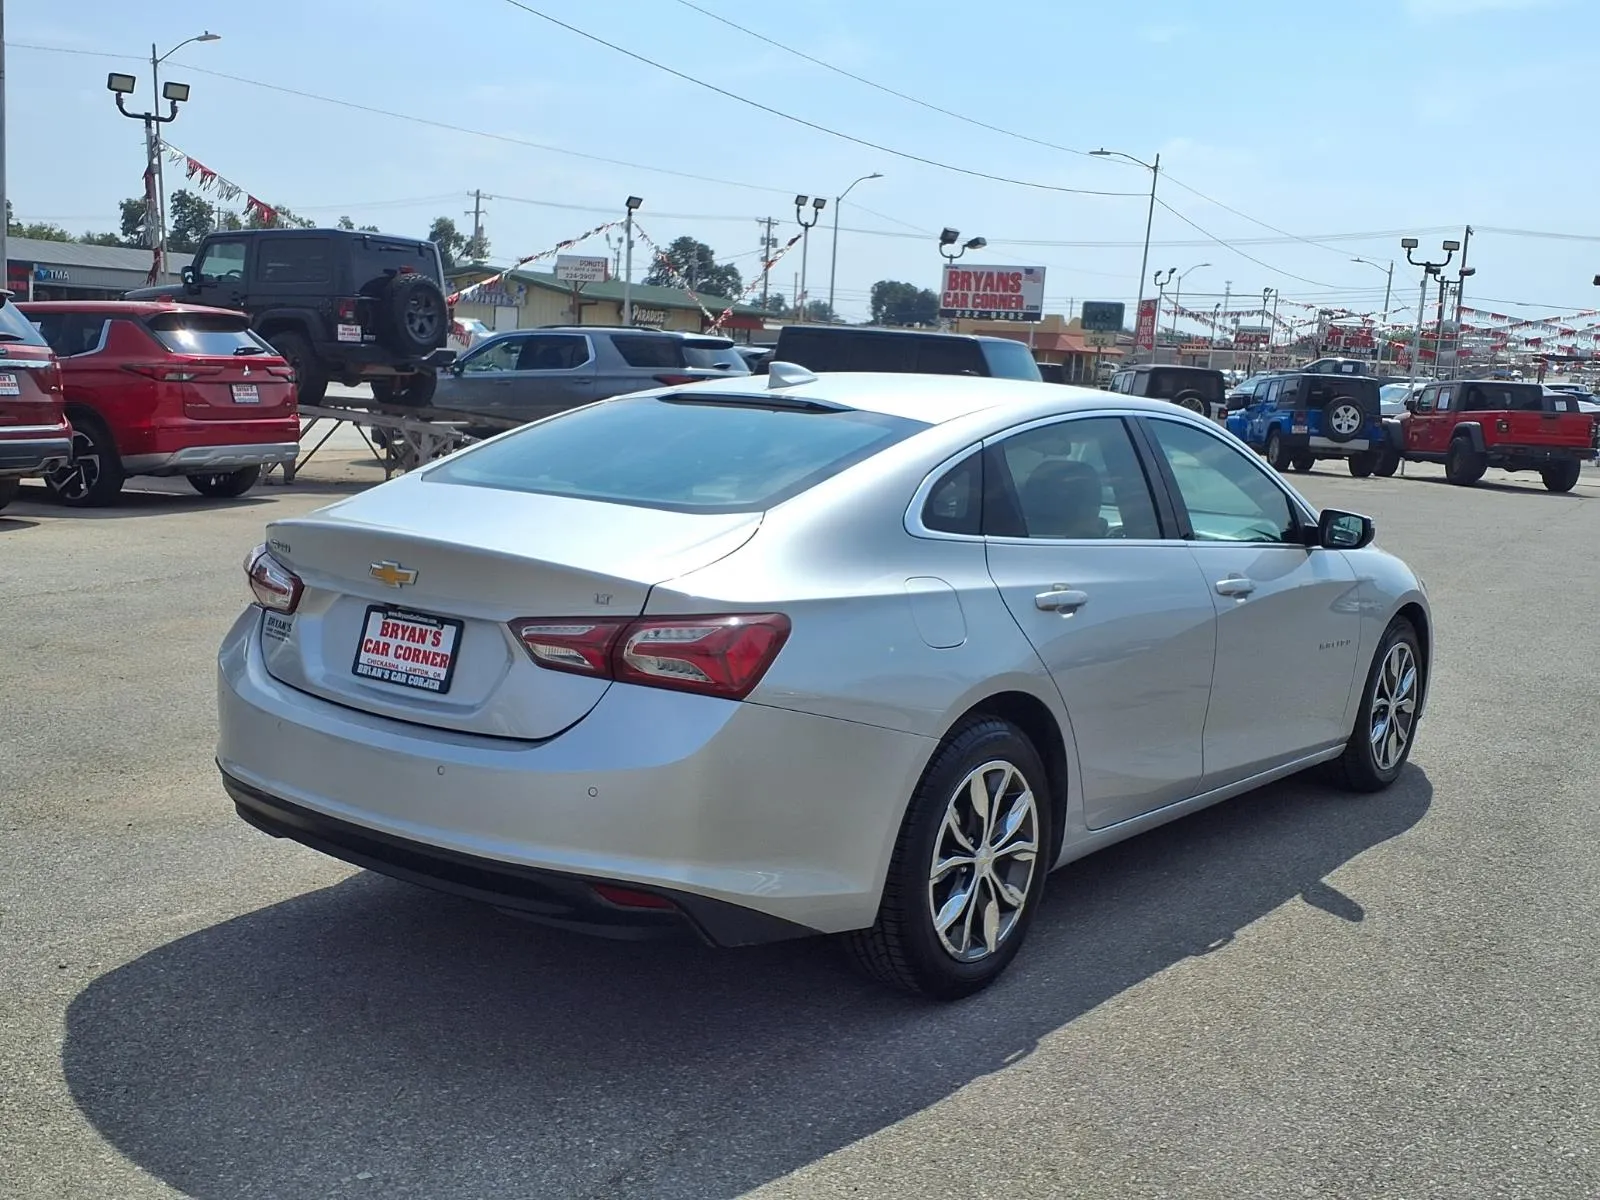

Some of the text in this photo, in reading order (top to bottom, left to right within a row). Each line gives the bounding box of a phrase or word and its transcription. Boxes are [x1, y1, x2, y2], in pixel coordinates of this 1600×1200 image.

[947, 270, 1022, 293] BRYANS
[943, 292, 1025, 310] CAR CORNER
[632, 304, 665, 322] PARADISE
[267, 616, 292, 633] BRYAN'S
[379, 620, 443, 648] BRYAN'S
[363, 638, 450, 669] CAR CORNER
[366, 657, 399, 670] CHICKASHA
[357, 663, 441, 691] BRYAN'S CAR CORNER
